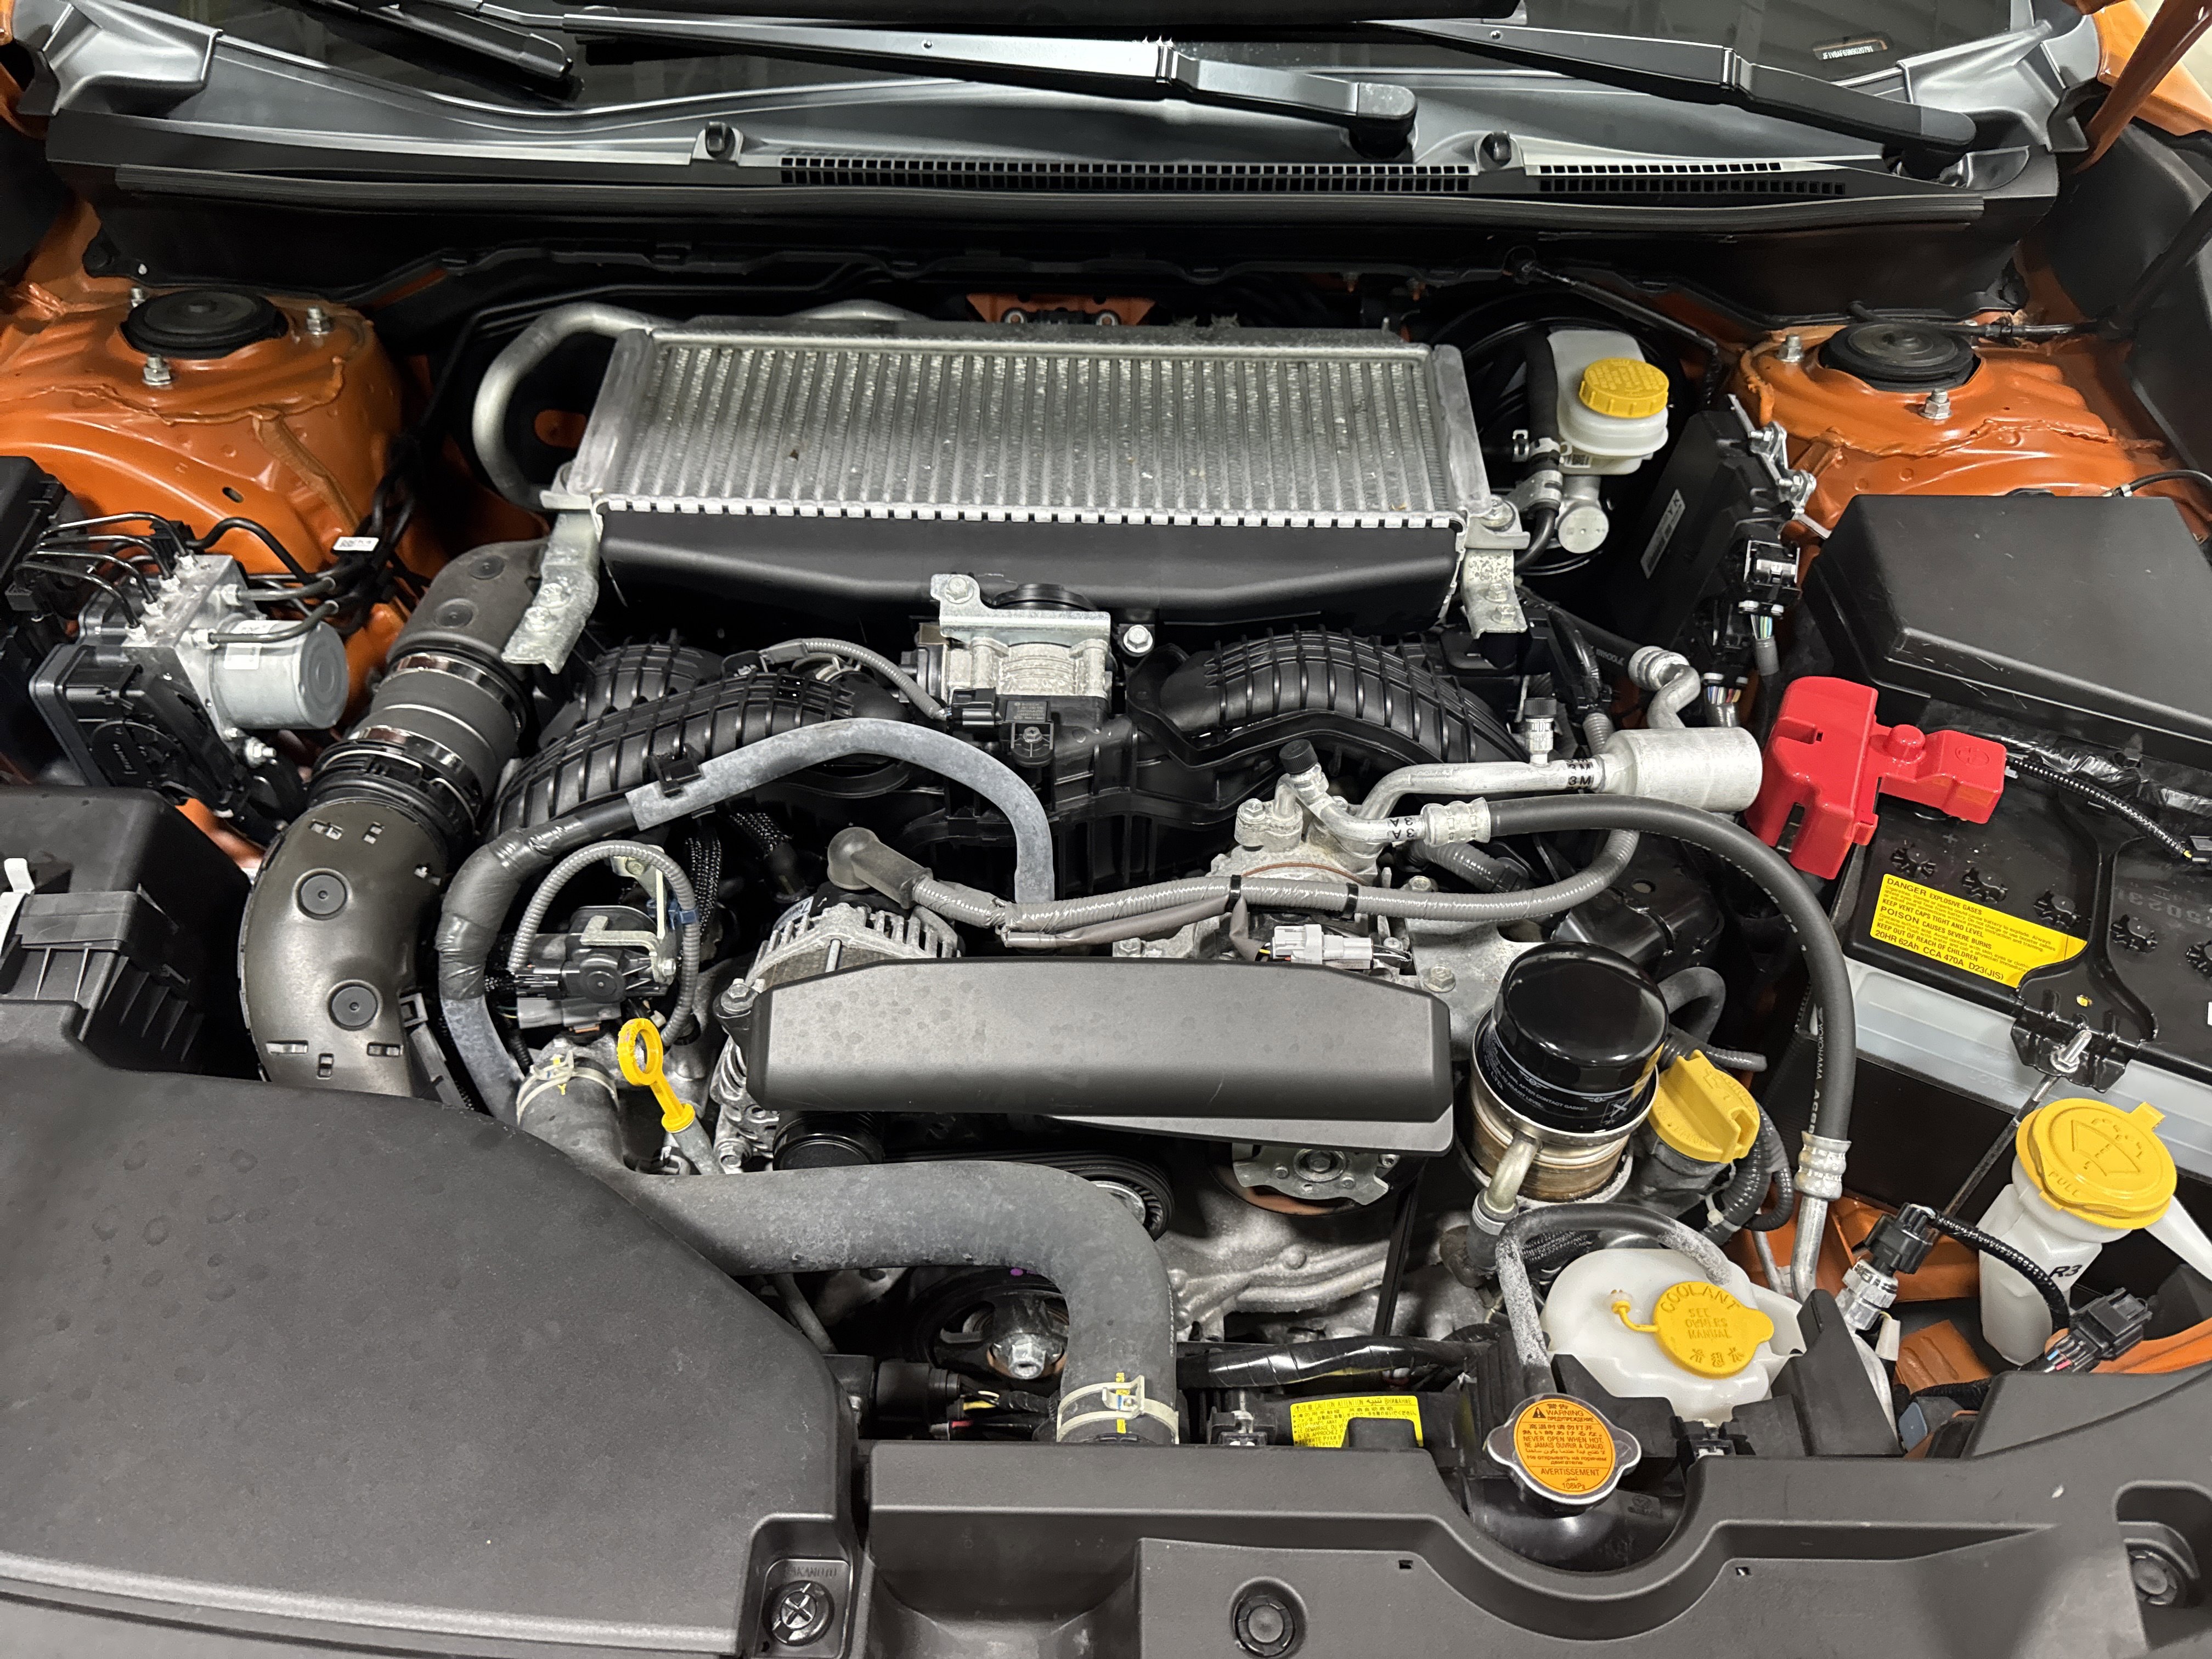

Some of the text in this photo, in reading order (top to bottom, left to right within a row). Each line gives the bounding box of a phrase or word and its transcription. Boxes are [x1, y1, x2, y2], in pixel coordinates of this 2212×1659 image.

[1887, 877, 1982, 915] DANGER EXPLOSIVE GASES
[1880, 905, 1992, 950] POISON CAUSES SEVERE BURNS
[1882, 898, 1984, 938] KEEP VENT CAPS TIGHT AND LEVEL
[1947, 915, 1966, 925] without
[1967, 922, 1984, 931] proper
[1984, 928, 2011, 941] instruction
[1968, 913, 1982, 922] cause
[1983, 918, 2002, 928] battery
[2032, 935, 2051, 945] Always
[1877, 921, 1978, 962] KEEP OUT OF REACH OF CHILDREN
[1933, 932, 1948, 940] Avoid
[1949, 938, 1967, 947] contact
[1994, 953, 2006, 962] eyes
[1933, 936, 1948, 945] water
[1974, 950, 1998, 963] physician
[1983, 923, 2001, 933] charge
[2019, 935, 2038, 945] booster
[2039, 942, 2056, 951] cables
[1875, 929, 2004, 981] 20HR 62Ah CCA 470A D23(JIS)
[1507, 1082, 1525, 1097] ADJUST
[1519, 1084, 1536, 1096] AFTER
[1537, 1094, 1563, 1107] CONTACT
[2049, 1265, 2083, 1278] R3
[1661, 1284, 1740, 1313] COOLANT
[1688, 1329, 1731, 1339] MANUAL
[1315, 1399, 1363, 1409] CAUTION ATTENTION
